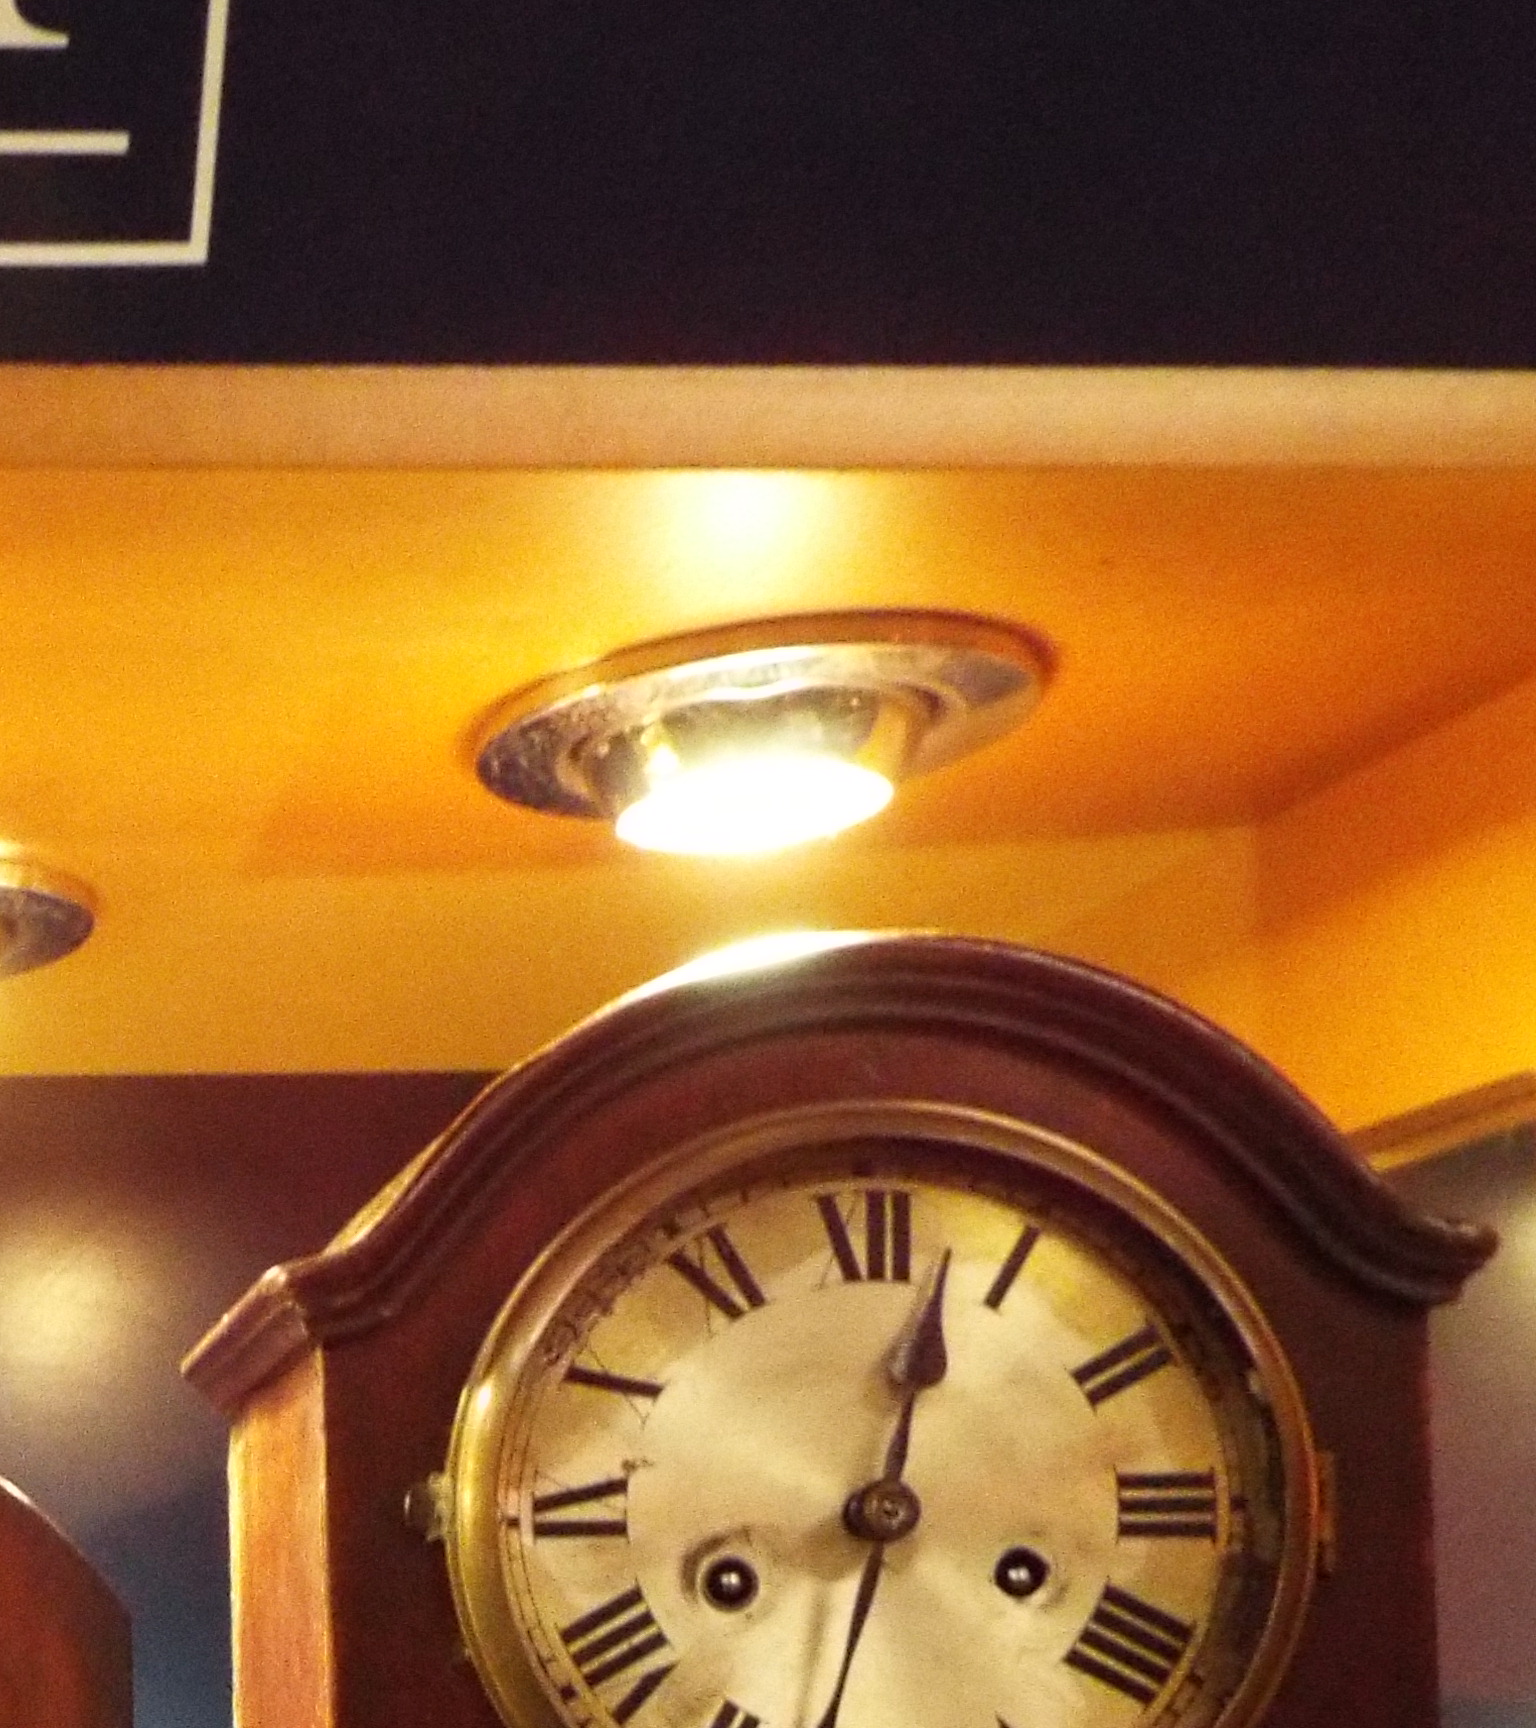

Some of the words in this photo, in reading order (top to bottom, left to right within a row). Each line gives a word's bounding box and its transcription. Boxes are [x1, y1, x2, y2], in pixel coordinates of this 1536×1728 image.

[812, 1188, 912, 1290] XII
[983, 1225, 1042, 1312] I
[1071, 1322, 1176, 1409] II
[1116, 1466, 1220, 1546] III
[1062, 1583, 1198, 1709] IIII
